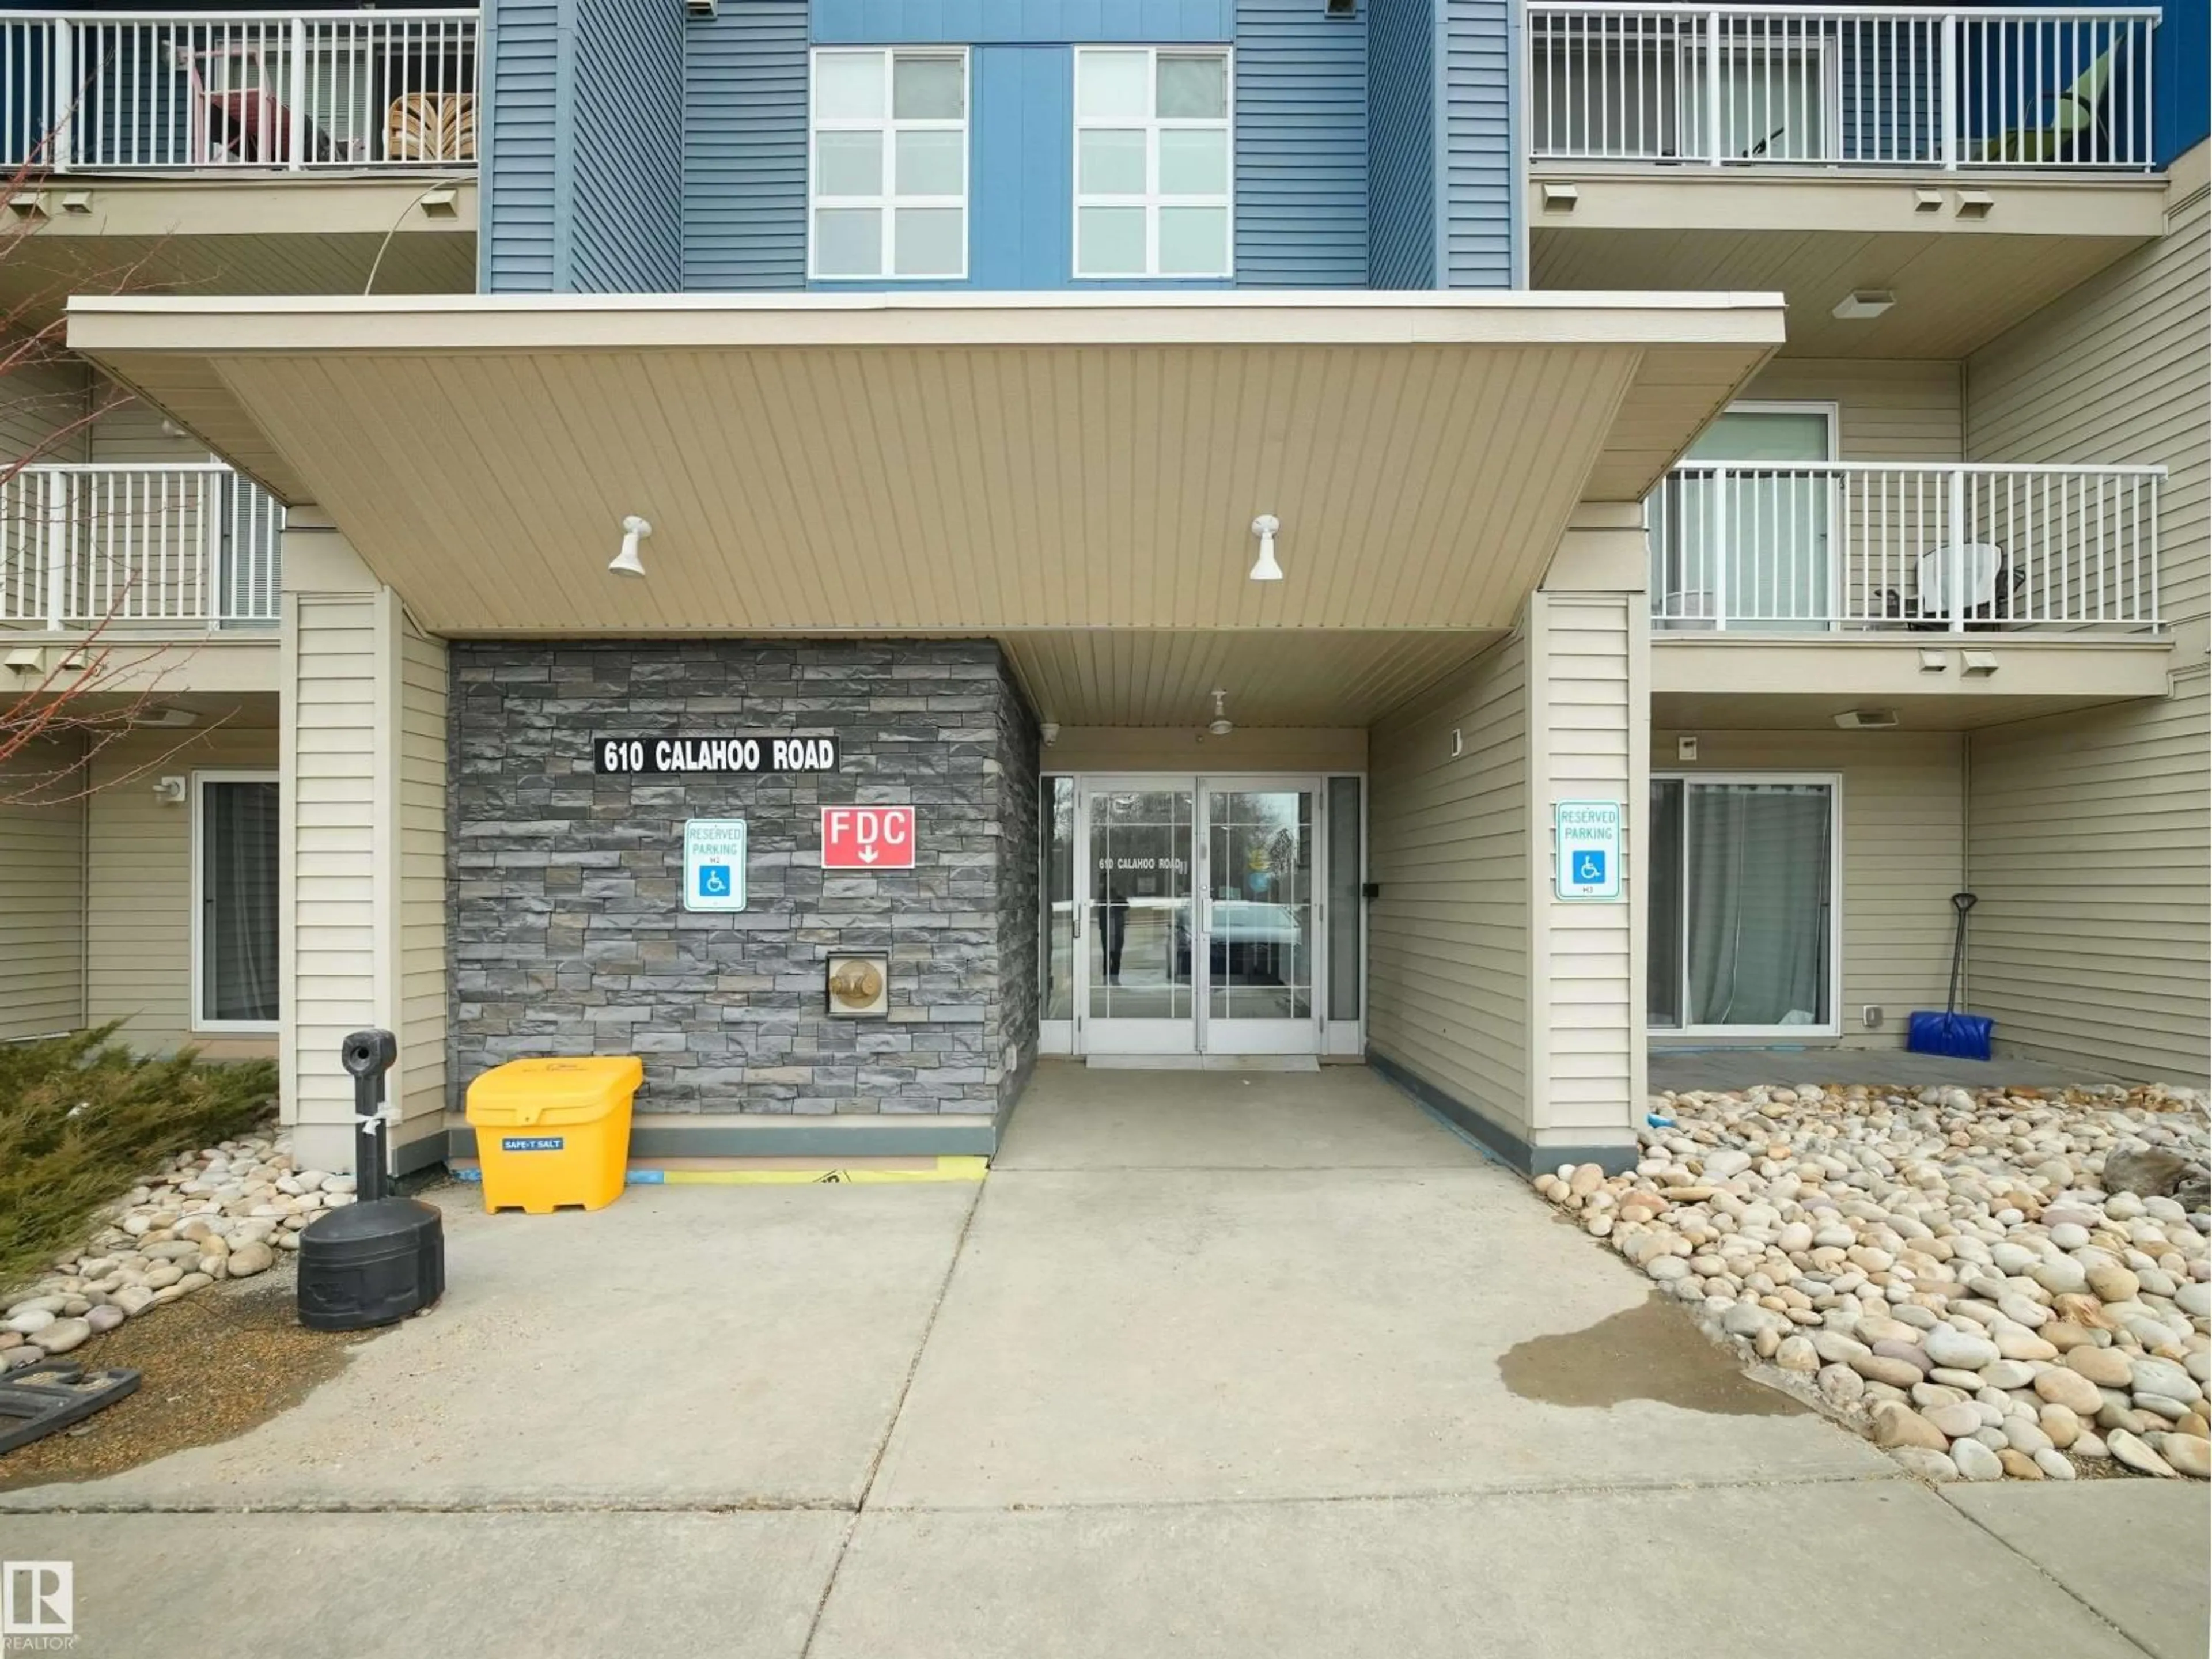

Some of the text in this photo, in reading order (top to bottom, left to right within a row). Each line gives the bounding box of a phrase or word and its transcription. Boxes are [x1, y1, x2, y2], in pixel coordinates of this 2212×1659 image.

[605, 739, 834, 771] 610 CALAHOO ROAD
[1561, 811, 1616, 823] RESERVED
[831, 811, 906, 844] FDC
[690, 828, 741, 840] RESERVED
[1565, 828, 1612, 839] PARKING
[692, 844, 737, 855] PARKING
[1099, 858, 1180, 869] 610 CALAHOO ROAD
[505, 1140, 560, 1149] SAFE-T SALT
